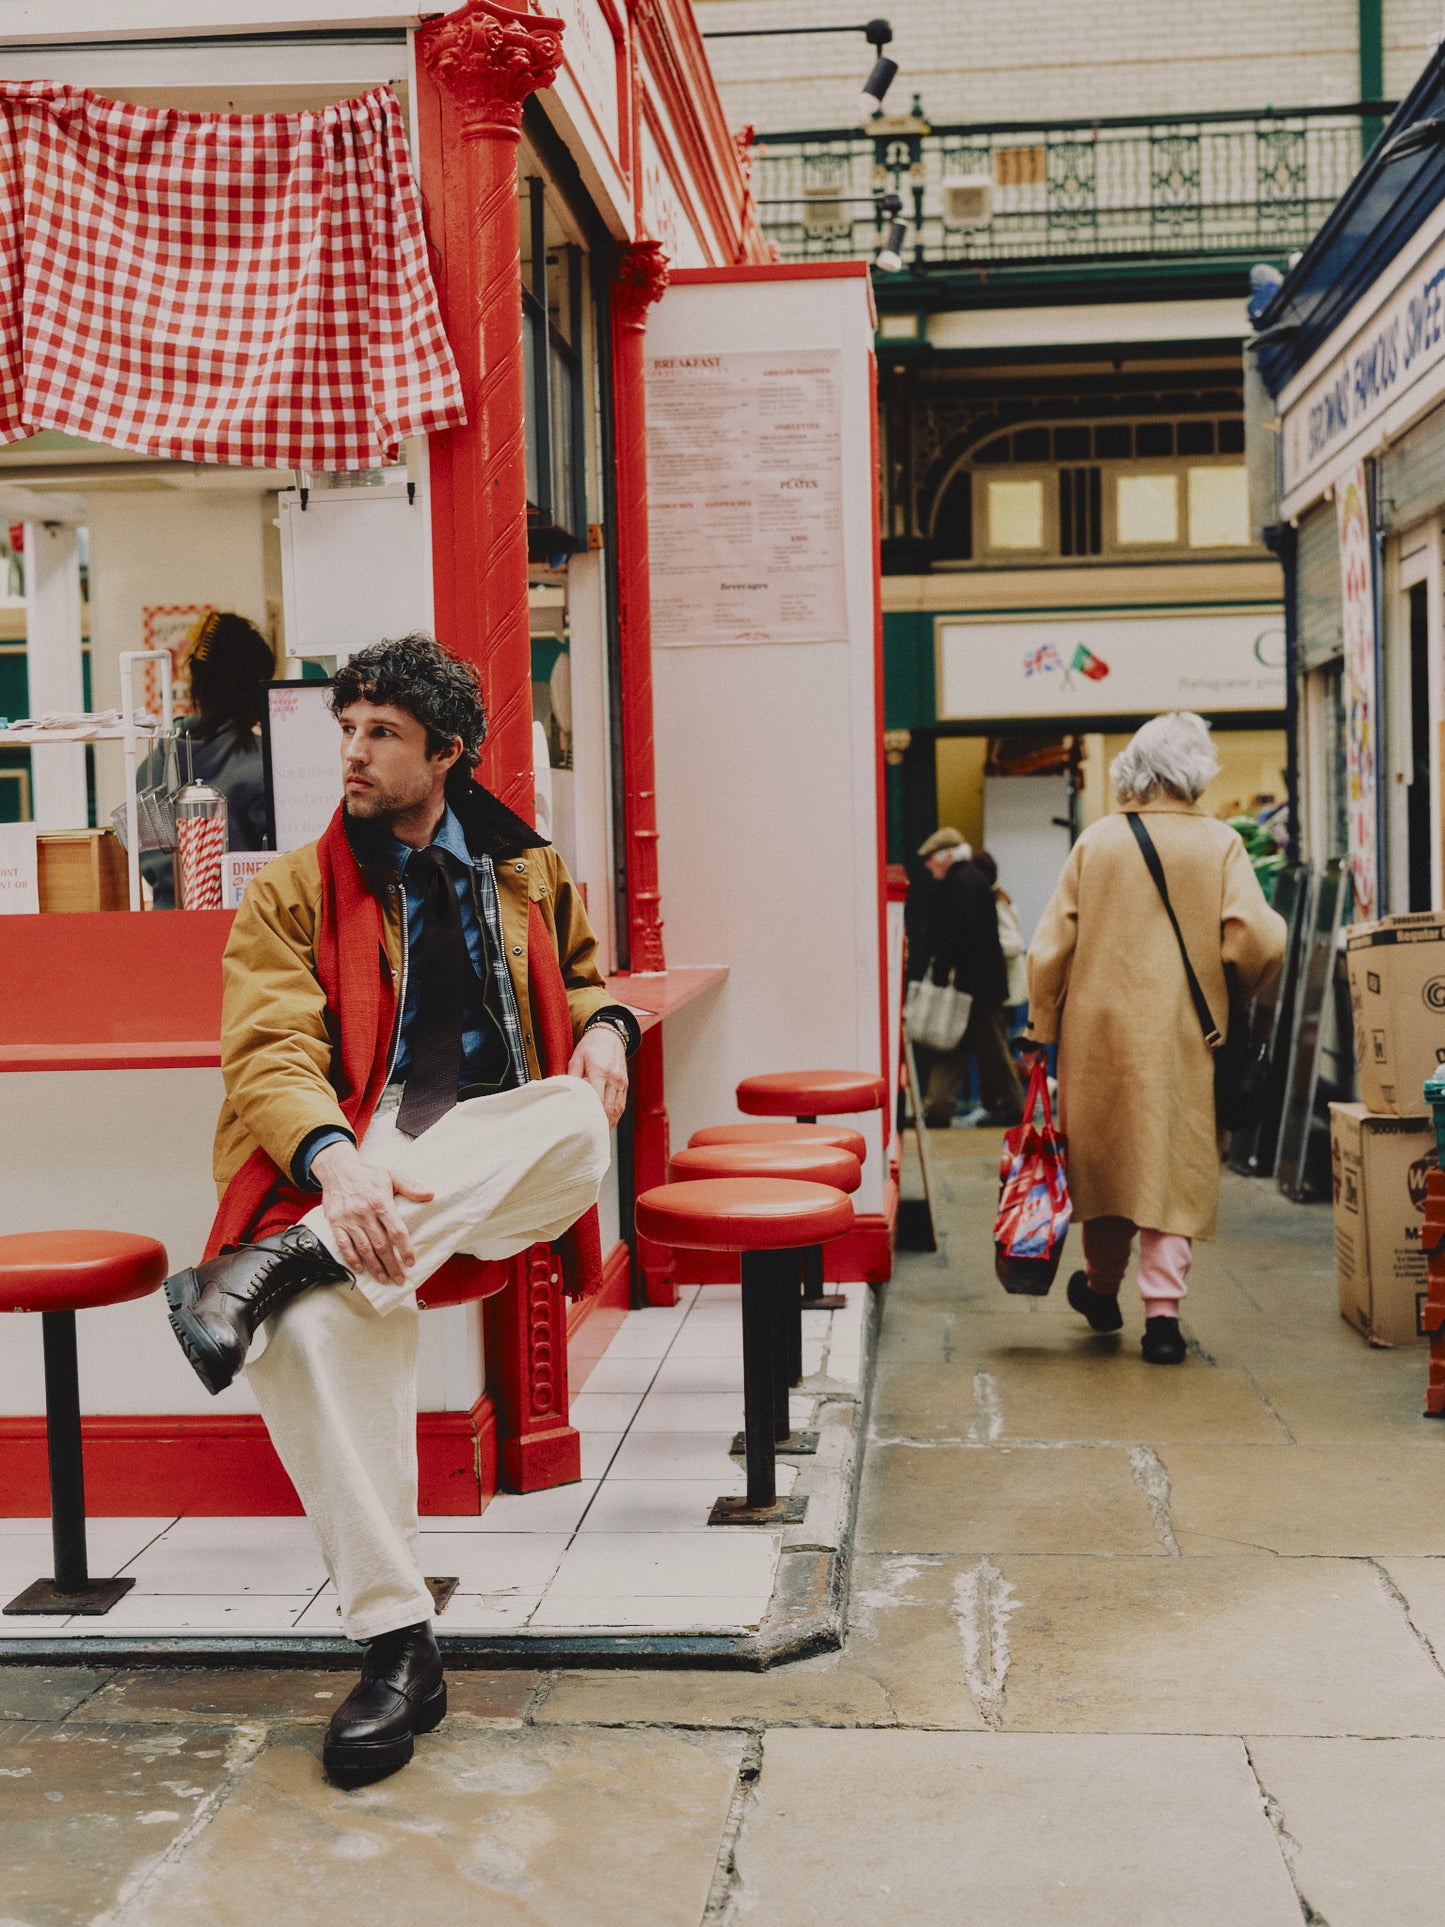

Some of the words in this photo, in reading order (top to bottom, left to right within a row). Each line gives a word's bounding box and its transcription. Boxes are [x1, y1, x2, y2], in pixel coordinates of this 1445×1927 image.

[653, 356, 721, 369] BREAKFAST
[720, 582, 768, 591] Beverages
[1396, 928, 1440, 944] Regular
